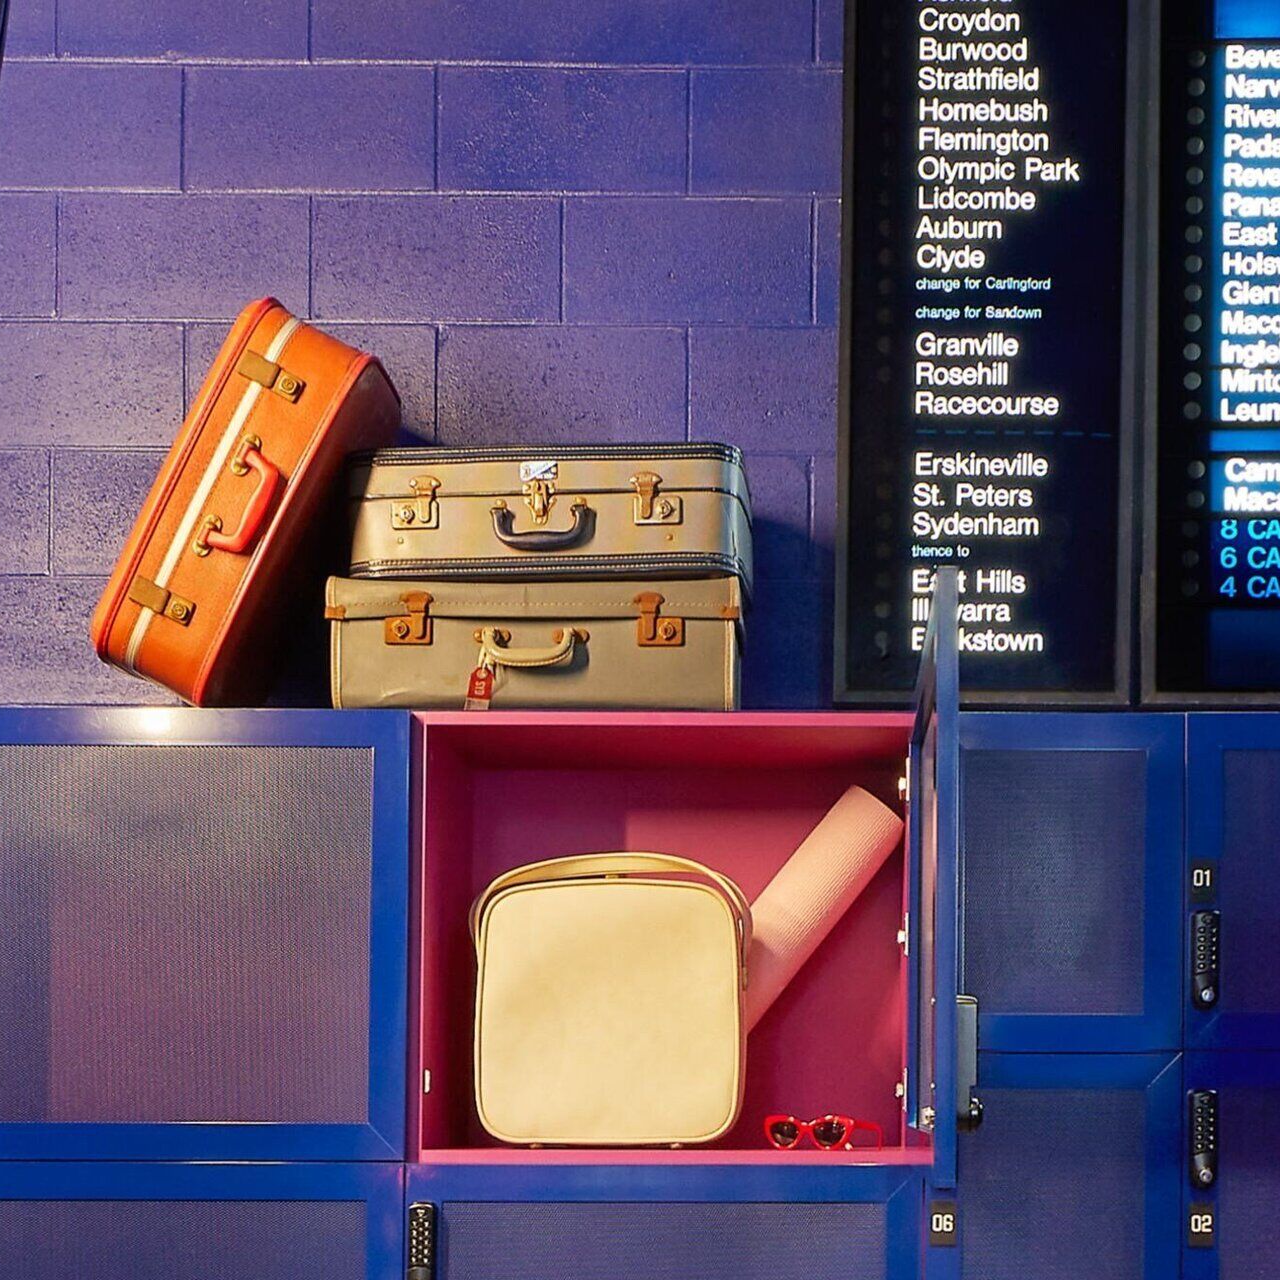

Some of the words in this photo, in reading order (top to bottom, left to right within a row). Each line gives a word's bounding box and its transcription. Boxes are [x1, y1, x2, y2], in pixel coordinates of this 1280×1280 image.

[918, 7, 1020, 37] Croydon
[919, 37, 1028, 63] Burwood
[917, 66, 1040, 92] Strathfield
[919, 97, 1048, 123] Homebush
[918, 126, 1049, 155] Flemington
[917, 157, 1016, 185] Olympic
[1025, 156, 1080, 182] Park
[918, 185, 1036, 211] Lidcombe
[915, 215, 1003, 240] Auburn
[1222, 221, 1278, 247] East
[916, 244, 986, 274] Clyde
[915, 277, 961, 293] change
[963, 276, 982, 290] for
[985, 276, 1052, 293] Carlingford
[914, 305, 961, 321] change
[963, 305, 982, 319] for
[985, 305, 1042, 320] Sandown
[915, 331, 1019, 357] Granville
[915, 361, 1009, 386] Rosehill
[915, 391, 1060, 416] Racecourse
[915, 452, 1049, 477] Erskineville
[912, 482, 946, 507] St.
[955, 482, 1033, 508] Peters
[912, 511, 1039, 541] Sydenham
[1220, 519, 1238, 540] 8
[911, 544, 954, 558] thence
[956, 544, 970, 558] to
[1220, 546, 1238, 569] 6
[911, 568, 968, 595] Eat
[976, 569, 1027, 594] Hills
[1220, 576, 1237, 597] 4
[911, 597, 1012, 623] Illarra
[911, 626, 1045, 653] Bkstown
[1193, 869, 1211, 887] 01
[931, 1214, 954, 1232] 06
[1190, 1214, 1212, 1233] 02
